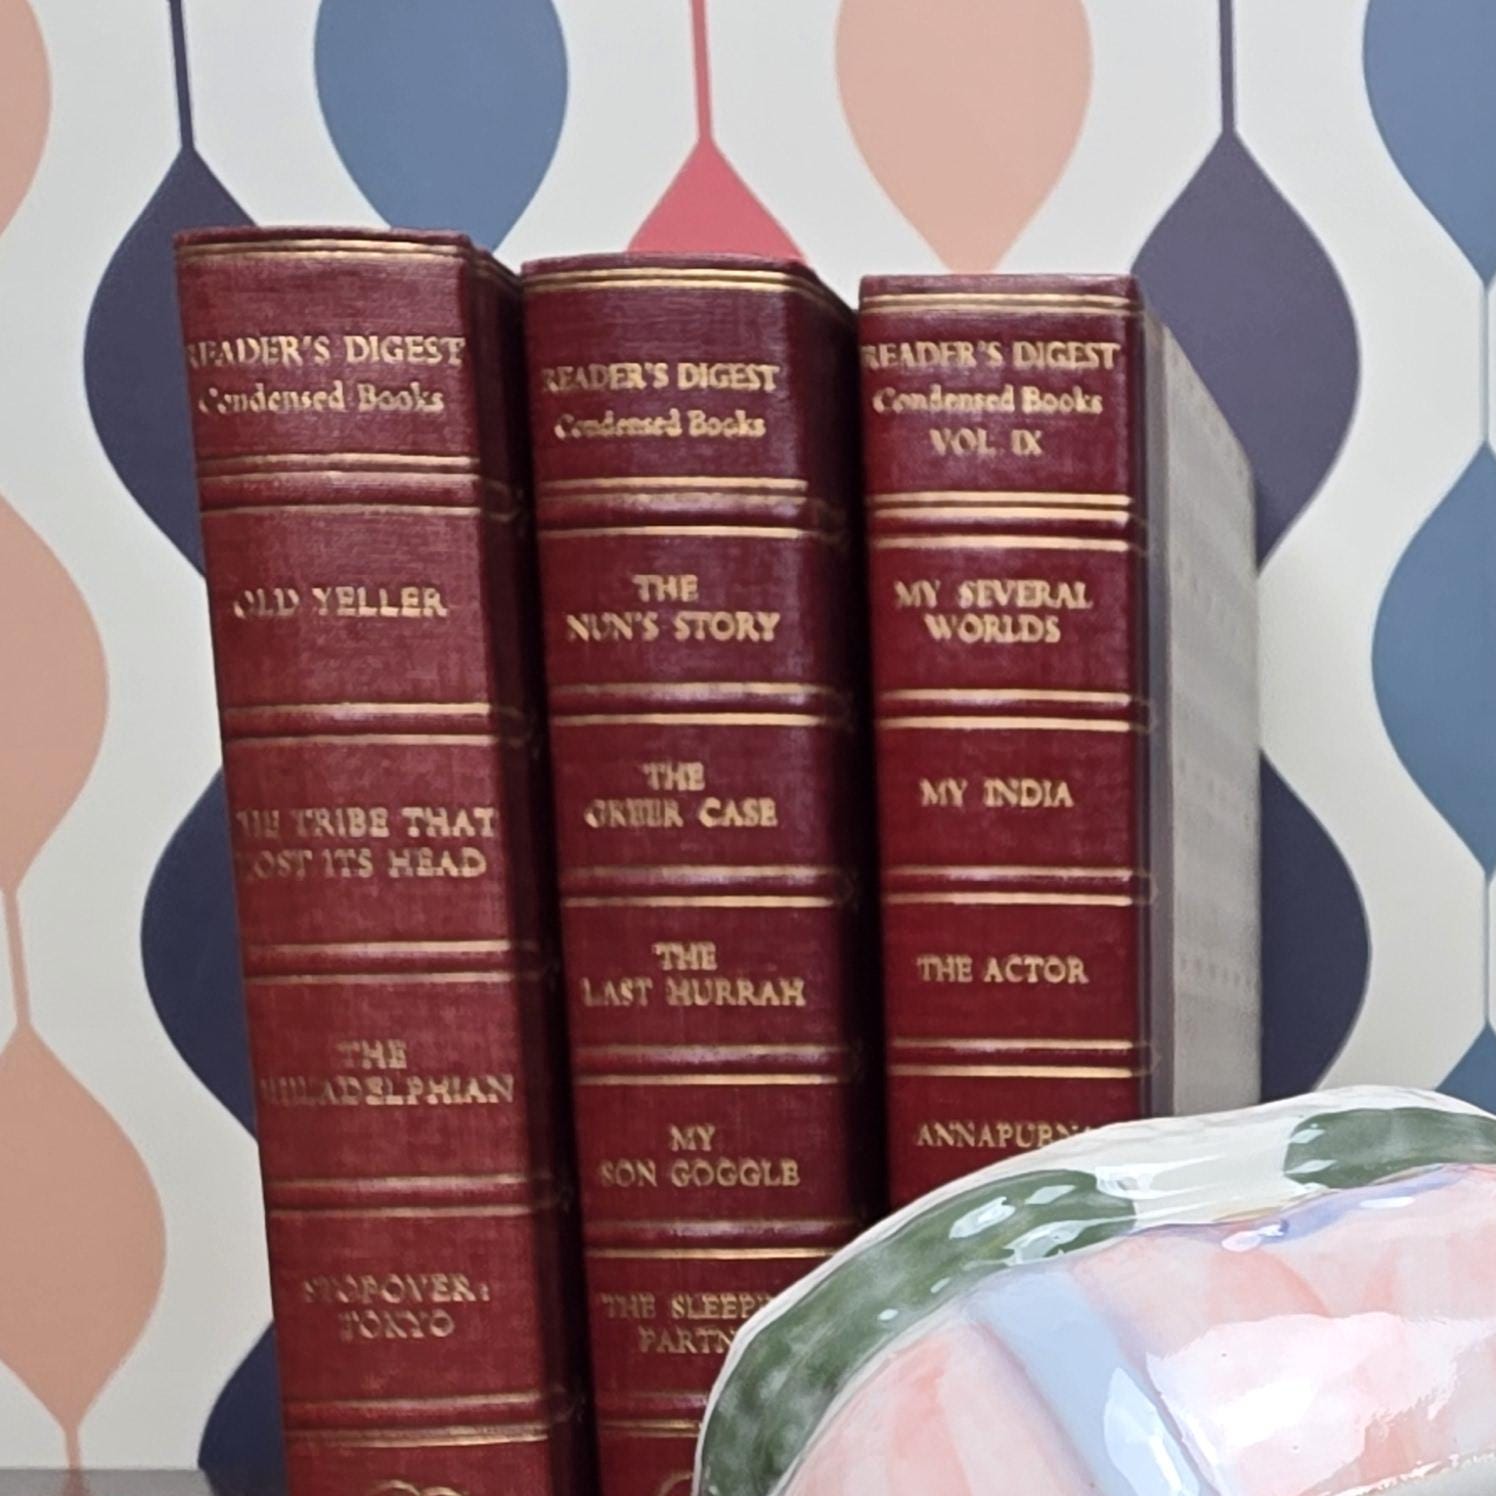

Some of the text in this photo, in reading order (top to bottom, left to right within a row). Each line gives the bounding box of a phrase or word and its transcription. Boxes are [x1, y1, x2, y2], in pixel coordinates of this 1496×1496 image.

[343, 334, 466, 367] DIGEST
[1012, 341, 1121, 370] DIGEST
[543, 362, 780, 391] READER'S DIGEST
[356, 381, 445, 413] Books
[872, 384, 1103, 414] Condensed Books
[554, 408, 766, 439] Condensed Books
[1010, 429, 1042, 456] IX
[311, 586, 448, 618] YELLER
[632, 574, 699, 602] THE
[894, 579, 1093, 609] MY SEVERAL
[566, 611, 780, 642] NUN'S STORY
[923, 613, 1061, 644] WORLDS
[641, 762, 706, 791] THE
[919, 777, 1075, 808] MY INDIA
[291, 807, 390, 838] TRIBE
[400, 806, 495, 838] THAT
[698, 796, 778, 828] CASE
[321, 848, 374, 878] ITS
[388, 846, 487, 878] HEAD
[652, 941, 718, 971] THE
[916, 953, 1090, 984] THE ACTOR
[581, 976, 806, 1008] LAST HURRAH
[335, 1038, 407, 1069] THE
[668, 1124, 716, 1152] MY
[600, 1158, 801, 1188] SON GOGGLE
[601, 1292, 656, 1320] THE
